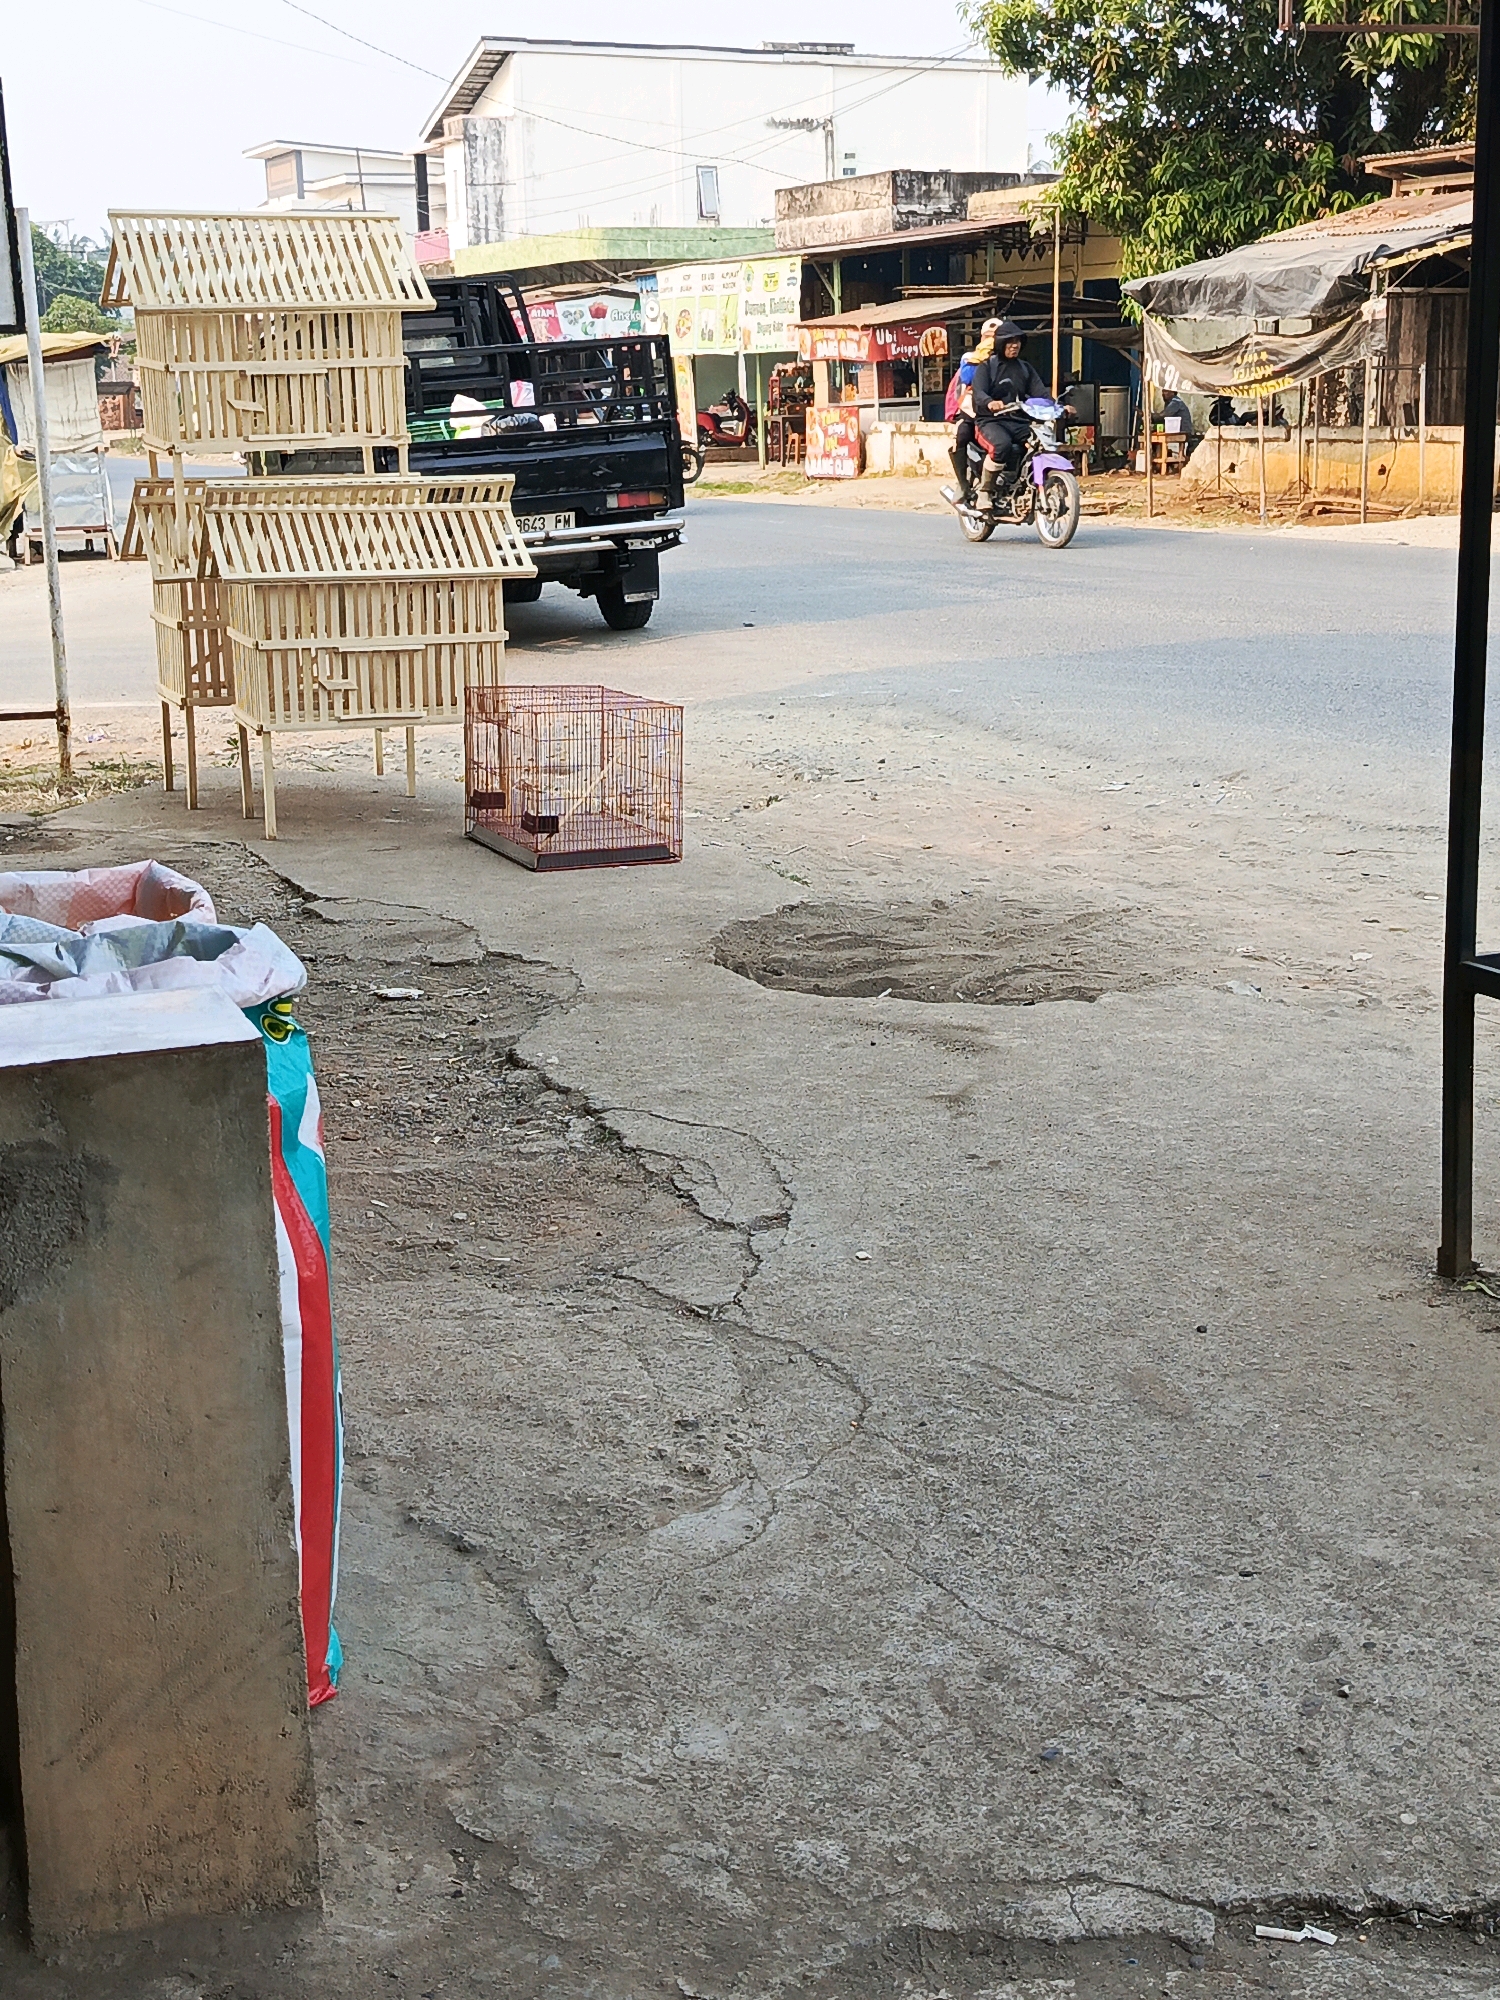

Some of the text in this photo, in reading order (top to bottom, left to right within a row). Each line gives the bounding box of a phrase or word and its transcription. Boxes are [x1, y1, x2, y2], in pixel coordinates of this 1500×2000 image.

[876, 328, 897, 345] Ubi
[891, 343, 918, 357] Krispy
[555, 514, 571, 529] FM
